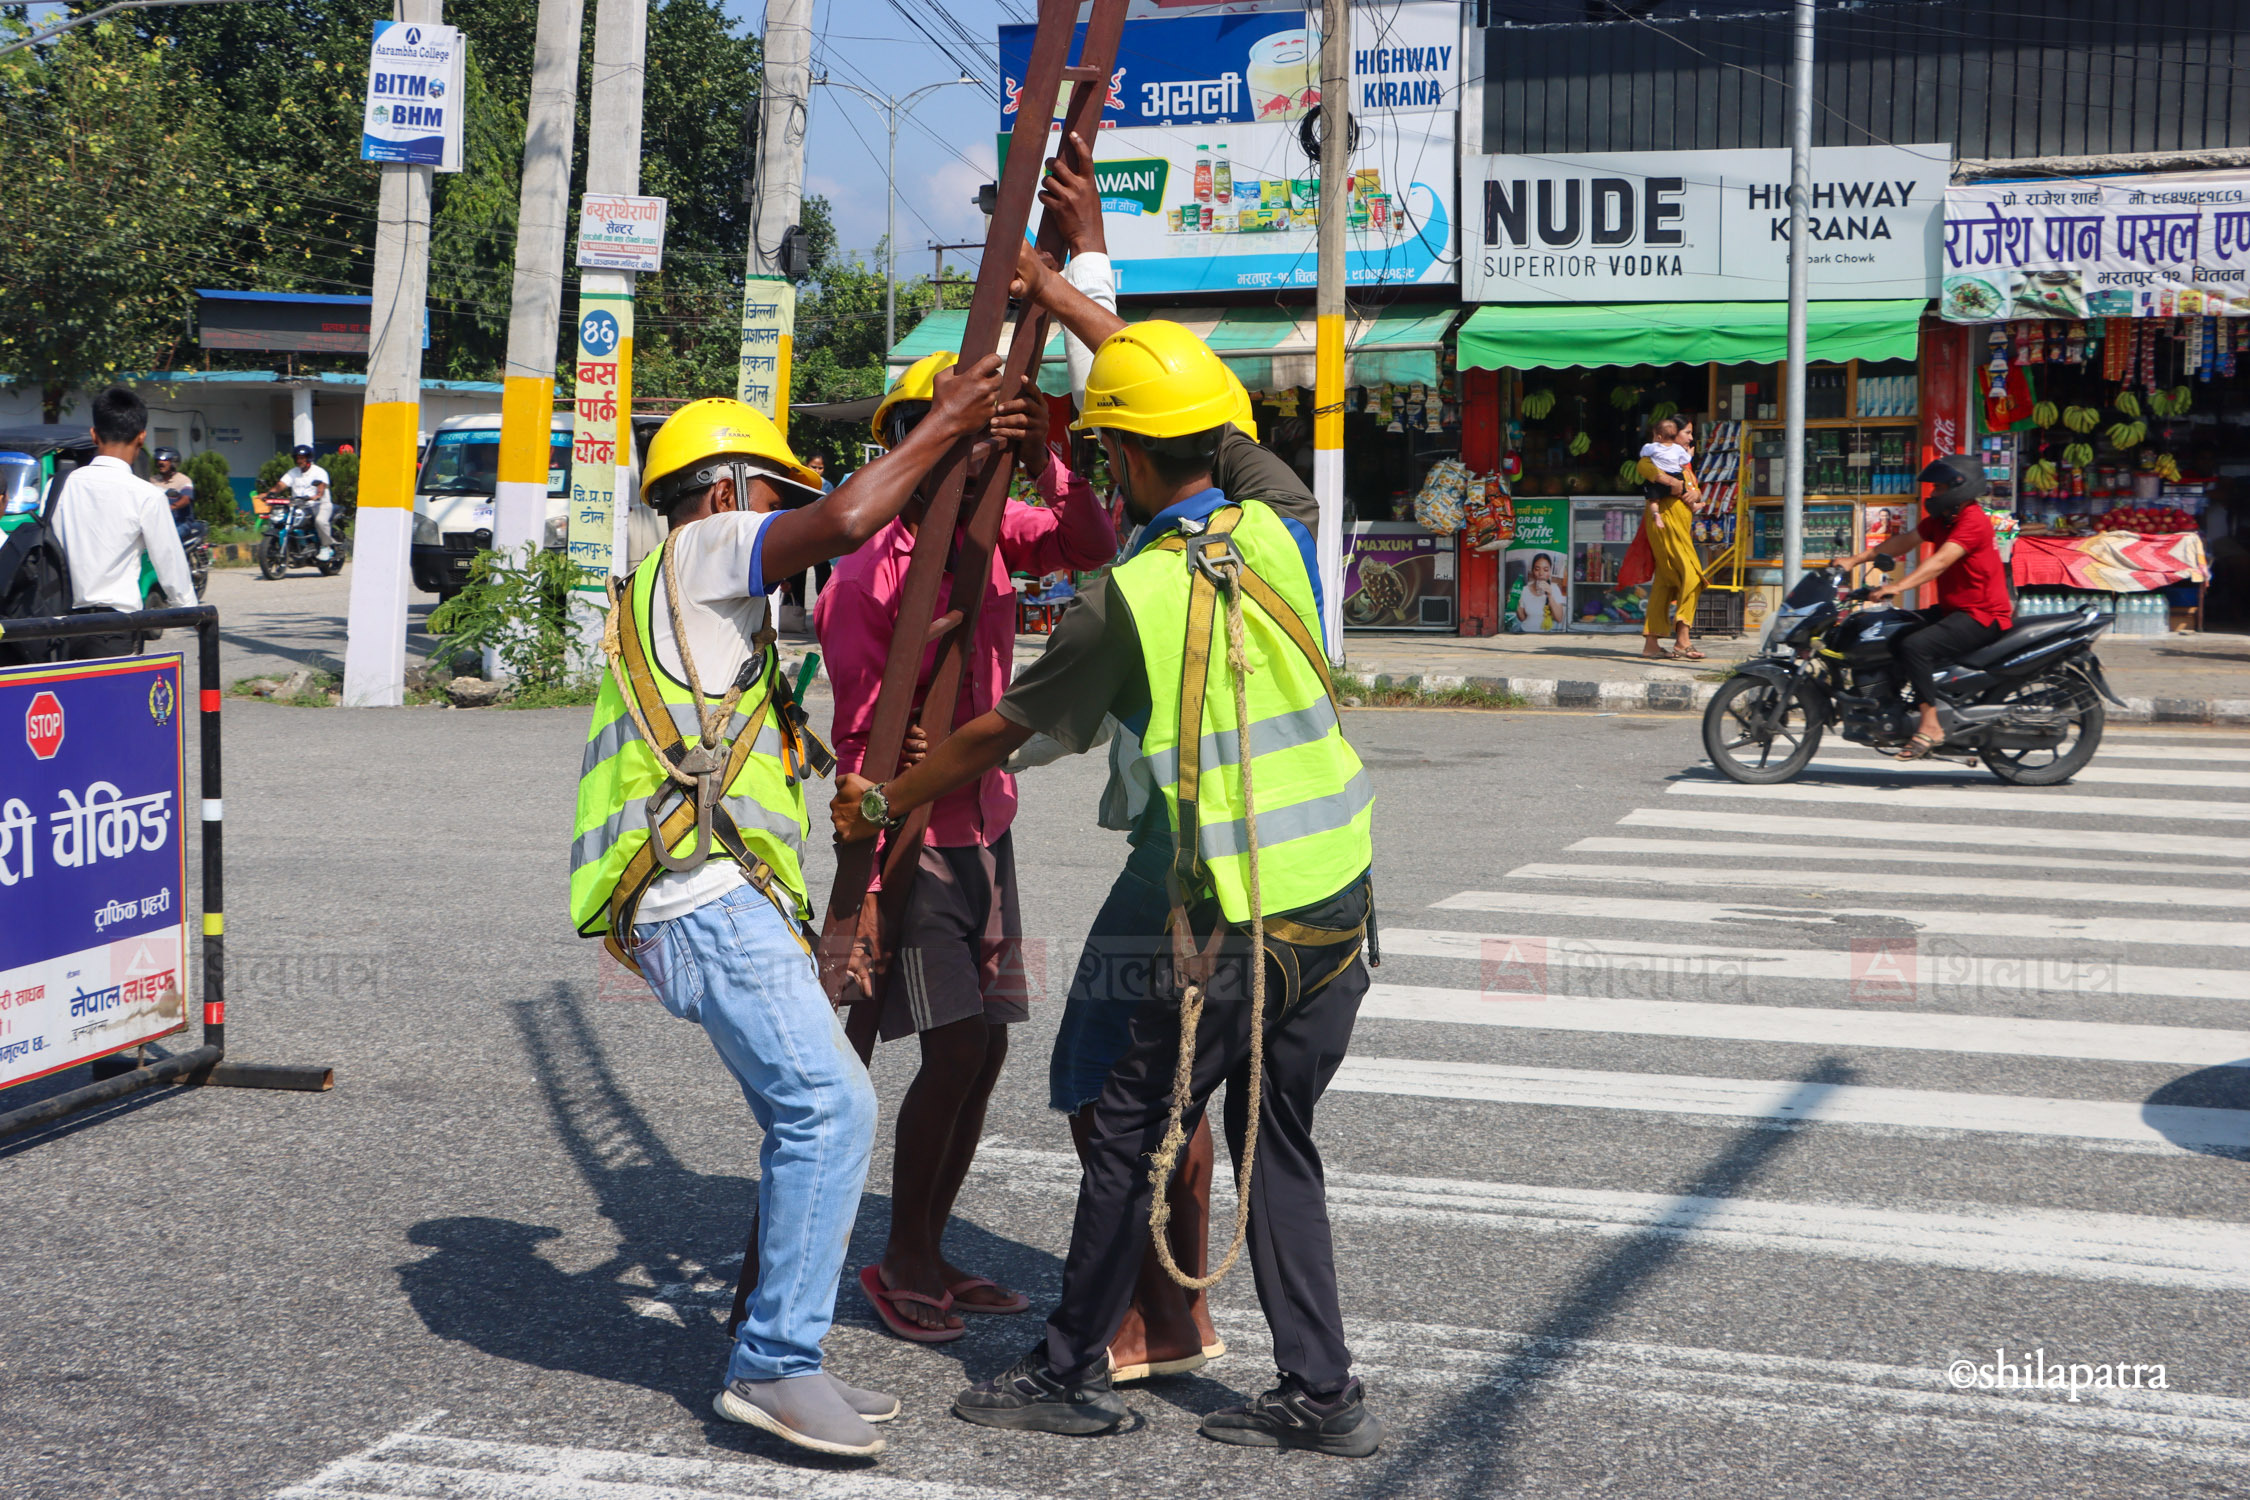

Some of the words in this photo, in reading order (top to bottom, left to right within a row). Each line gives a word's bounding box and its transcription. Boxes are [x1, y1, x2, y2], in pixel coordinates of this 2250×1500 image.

[375, 44, 417, 58] Aarambha
[419, 47, 449, 62] College
[1355, 46, 1452, 75] HIGHWAY
[374, 72, 427, 97] BITM
[1141, 72, 1242, 117] असली
[1364, 80, 1441, 108] KIRANA
[392, 105, 443, 128] BHM
[2025, 190, 2066, 205] राजेश
[2071, 192, 2099, 205] शाह
[1484, 177, 1687, 250] NUDE
[606, 220, 635, 235] सेन्टर
[1771, 216, 1892, 241] KRANA
[1944, 202, 2034, 268] राजेश
[2045, 216, 2105, 263] पान
[2116, 213, 2203, 266] पसल
[1484, 256, 1597, 277] SUPERIOR
[1609, 255, 1683, 276] VODKA
[1835, 253, 1875, 264] Chowk
[2192, 266, 2246, 284] चितवन
[745, 298, 779, 320] जिल्ला
[583, 319, 616, 350] ४६
[741, 328, 779, 345] प्रशासन
[578, 362, 617, 385] बस
[741, 356, 776, 374] एकता
[578, 390, 617, 422] पार्क
[574, 431, 615, 464] चोक
[1515, 525, 1554, 540] Sprite
[30, 713, 60, 739] STOP
[50, 781, 172, 867] चेकिङ
[94, 900, 138, 933] ट्राफिक
[141, 887, 170, 918] प्रहरी
[15, 985, 46, 1006] साधन
[70, 986, 121, 1017] नेपाल
